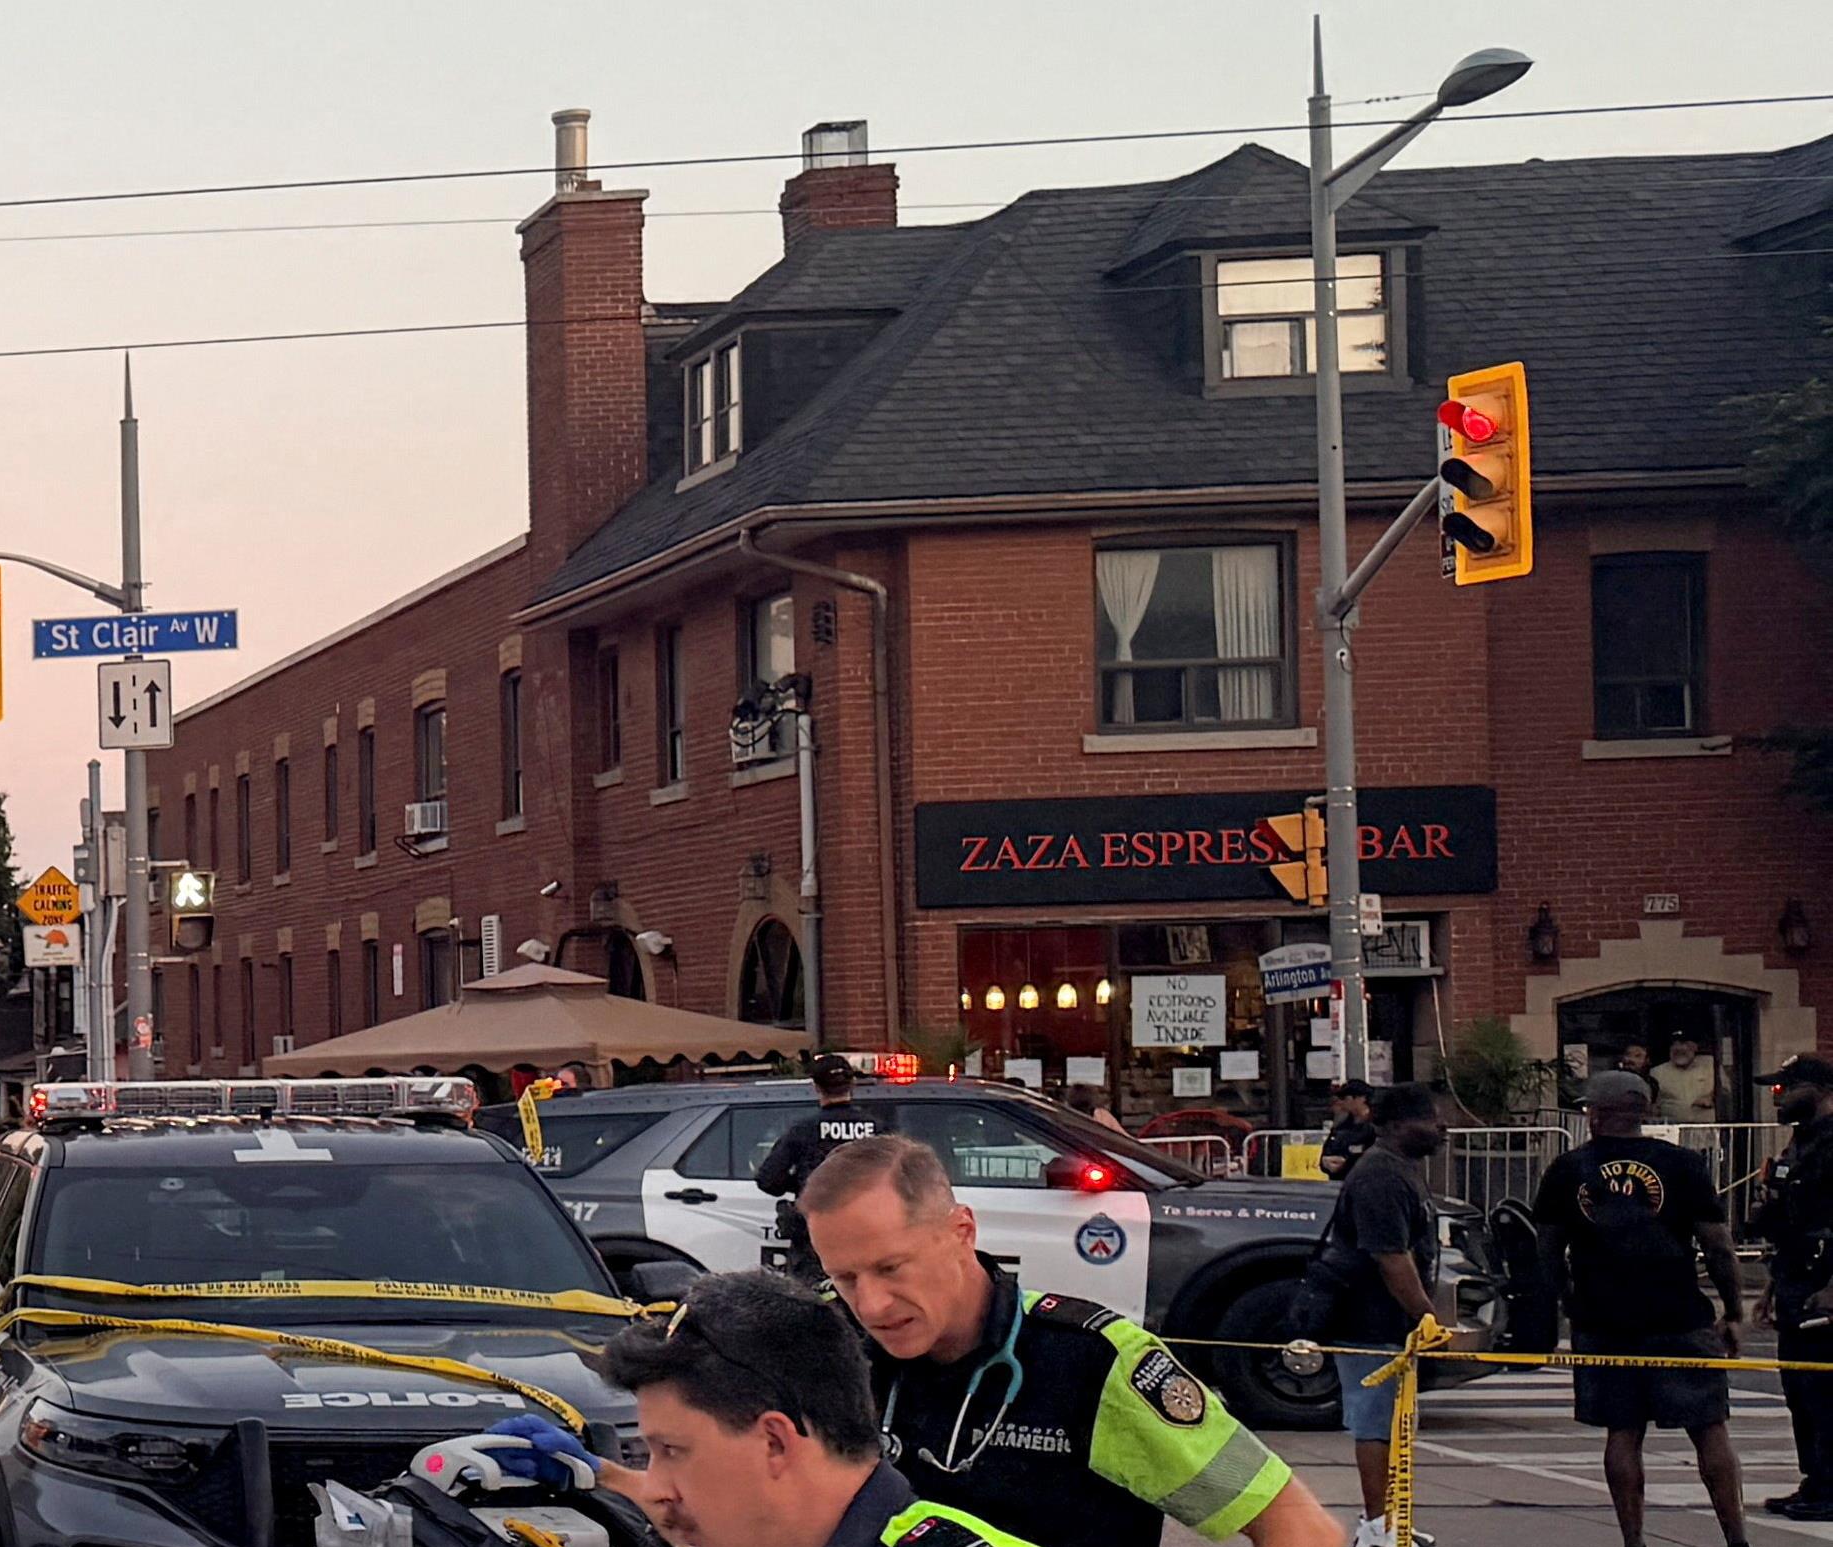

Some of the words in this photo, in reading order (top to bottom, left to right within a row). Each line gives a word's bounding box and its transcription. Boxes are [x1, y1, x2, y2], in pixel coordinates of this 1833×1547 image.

[51, 625, 80, 651] St
[92, 620, 159, 649] Clair
[170, 618, 189, 633] Av
[194, 616, 219, 644] W
[959, 835, 1091, 872] ZAZA
[1099, 826, 1289, 869] ESPRES
[1356, 824, 1455, 860] BAR
[35, 884, 71, 896] TRAFFIC
[33, 899, 73, 911] CALMING
[1647, 895, 1678, 911] 775
[43, 915, 64, 926] ZONE
[1165, 976, 1189, 992] NO
[1264, 968, 1317, 989] Arlington
[1146, 1009, 1210, 1024] AVAILABLE
[1152, 1026, 1206, 1043] INSIDE
[820, 1121, 875, 1141] POLICE
[1162, 1205, 1181, 1216] To
[1185, 1205, 1233, 1217] Serve
[1237, 1207, 1250, 1218] &
[1254, 1207, 1316, 1220] Protect
